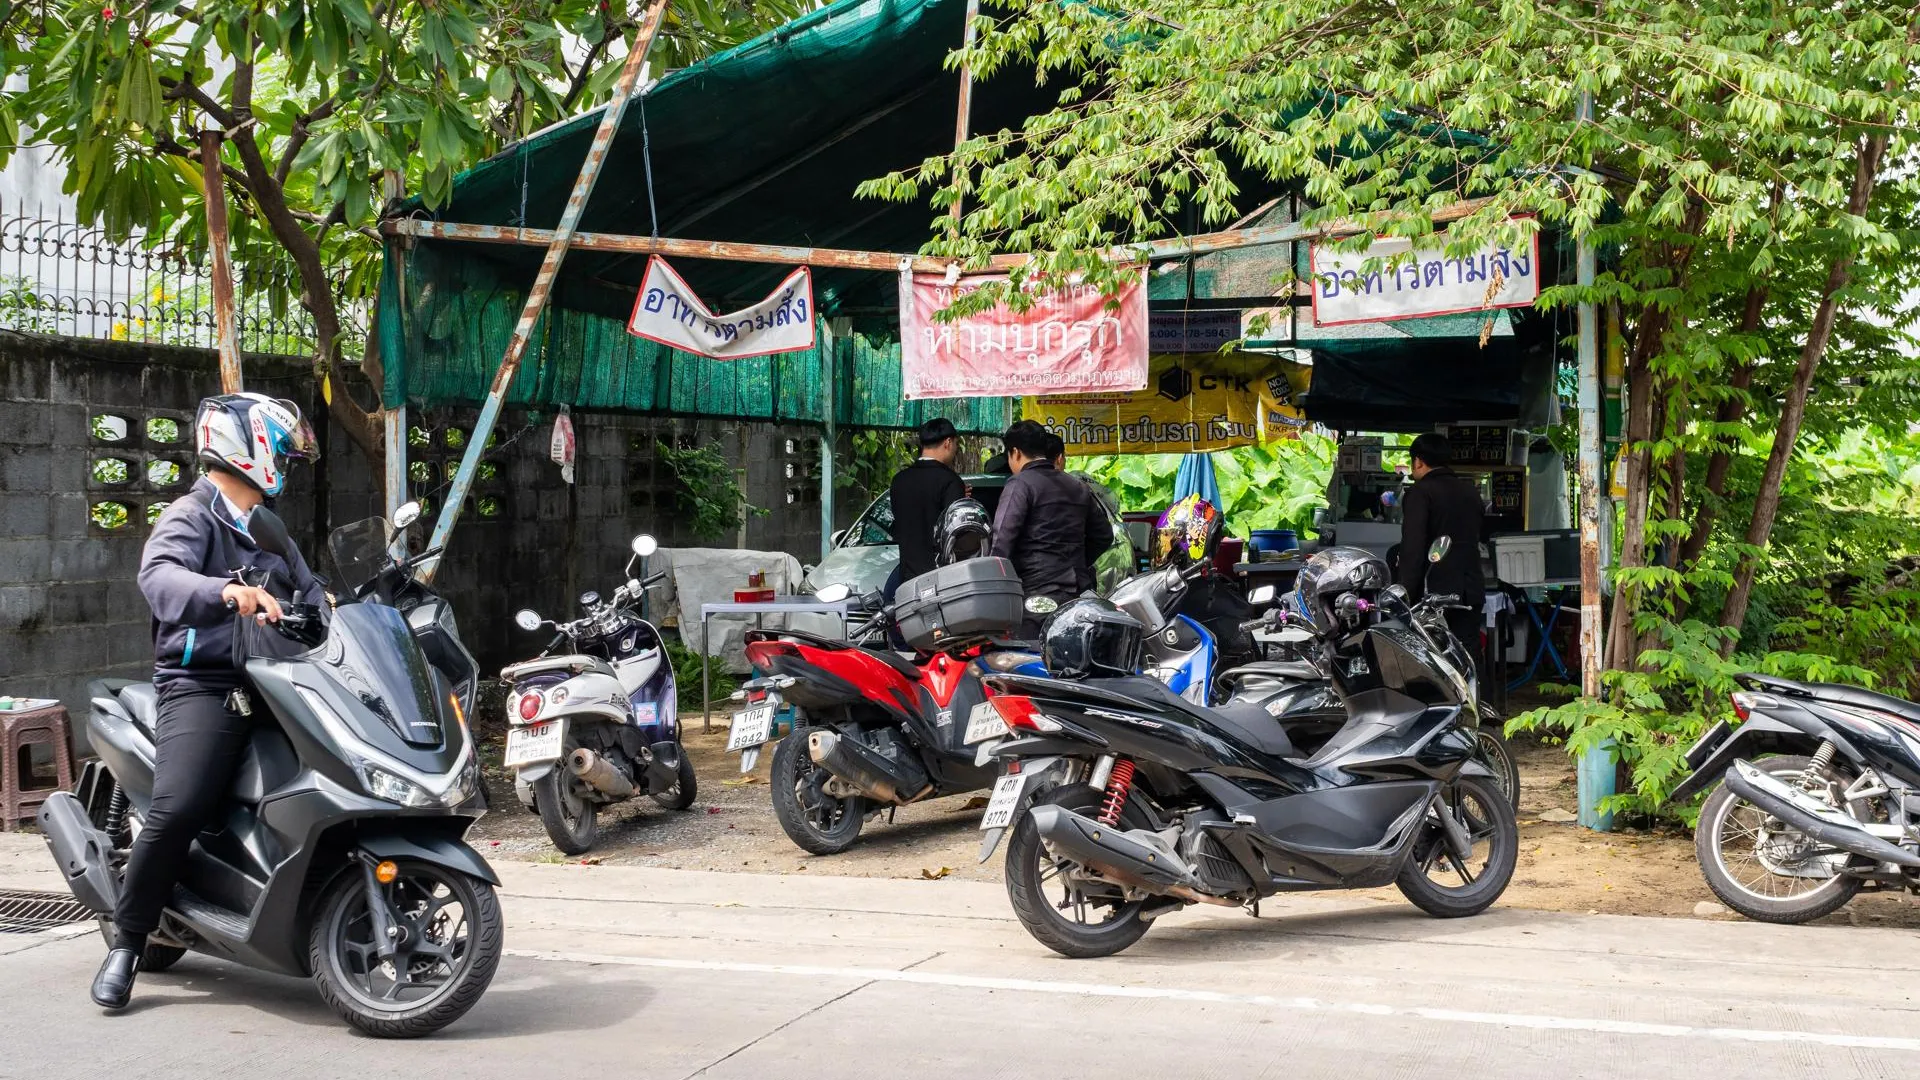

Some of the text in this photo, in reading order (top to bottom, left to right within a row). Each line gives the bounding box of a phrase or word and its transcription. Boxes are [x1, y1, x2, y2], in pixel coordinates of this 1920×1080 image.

[923, 318, 1122, 369] หามบุกรุก
[1044, 415, 1200, 443] ำให้ภายในรถ
[734, 731, 763, 748] 8942
[987, 810, 1008, 825] 9770
